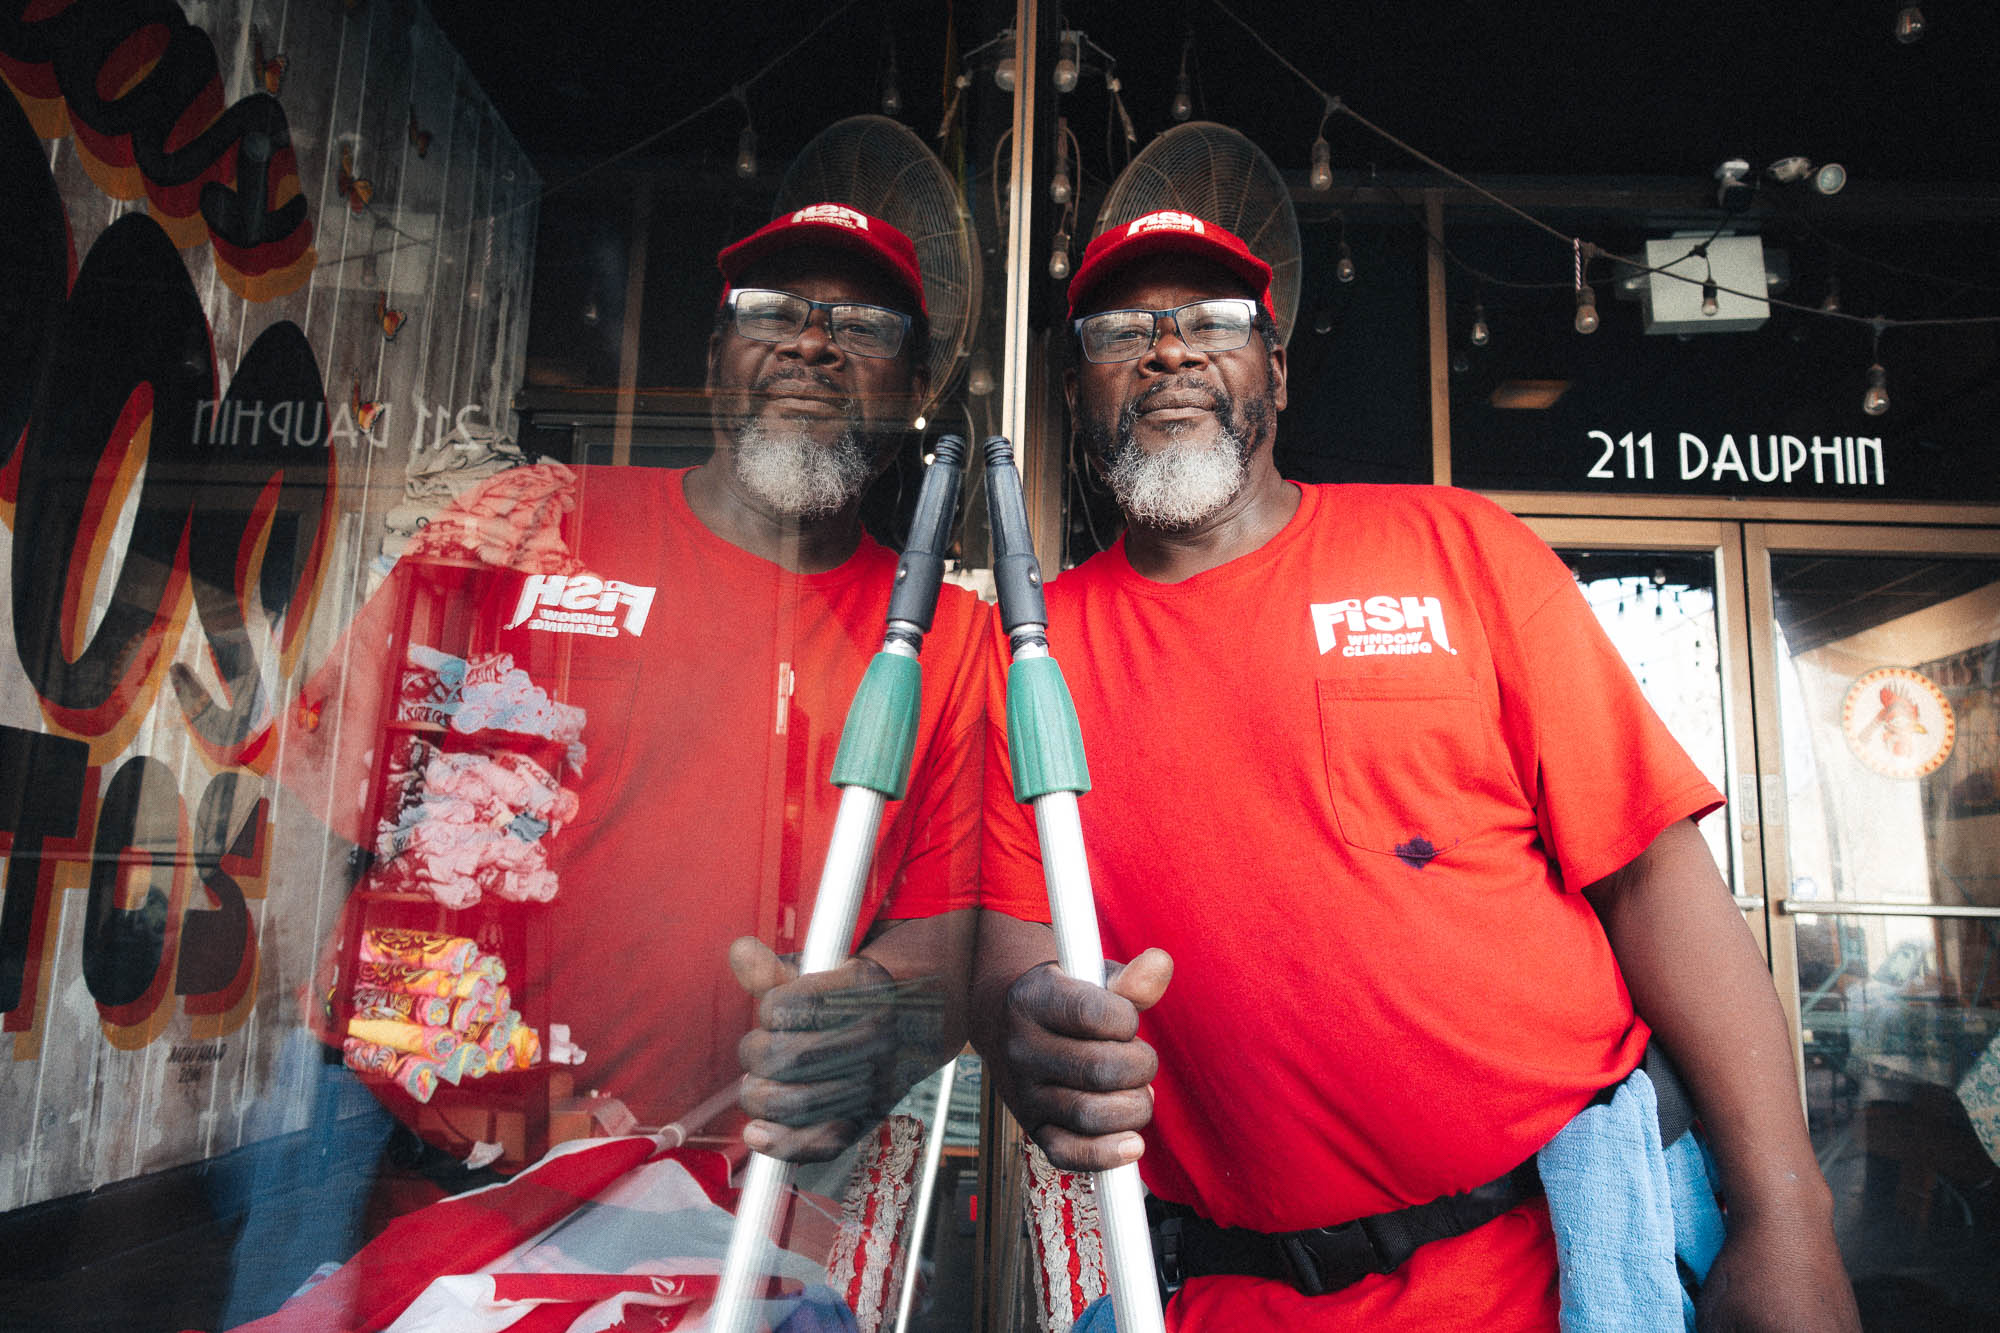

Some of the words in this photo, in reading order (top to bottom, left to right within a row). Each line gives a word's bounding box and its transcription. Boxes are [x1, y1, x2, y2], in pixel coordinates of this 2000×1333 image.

[1586, 429, 1655, 480] 211
[1678, 431, 1886, 485] DAUPHIN
[1346, 631, 1423, 646] WINDOW
[1342, 641, 1433, 658] CLEANING
